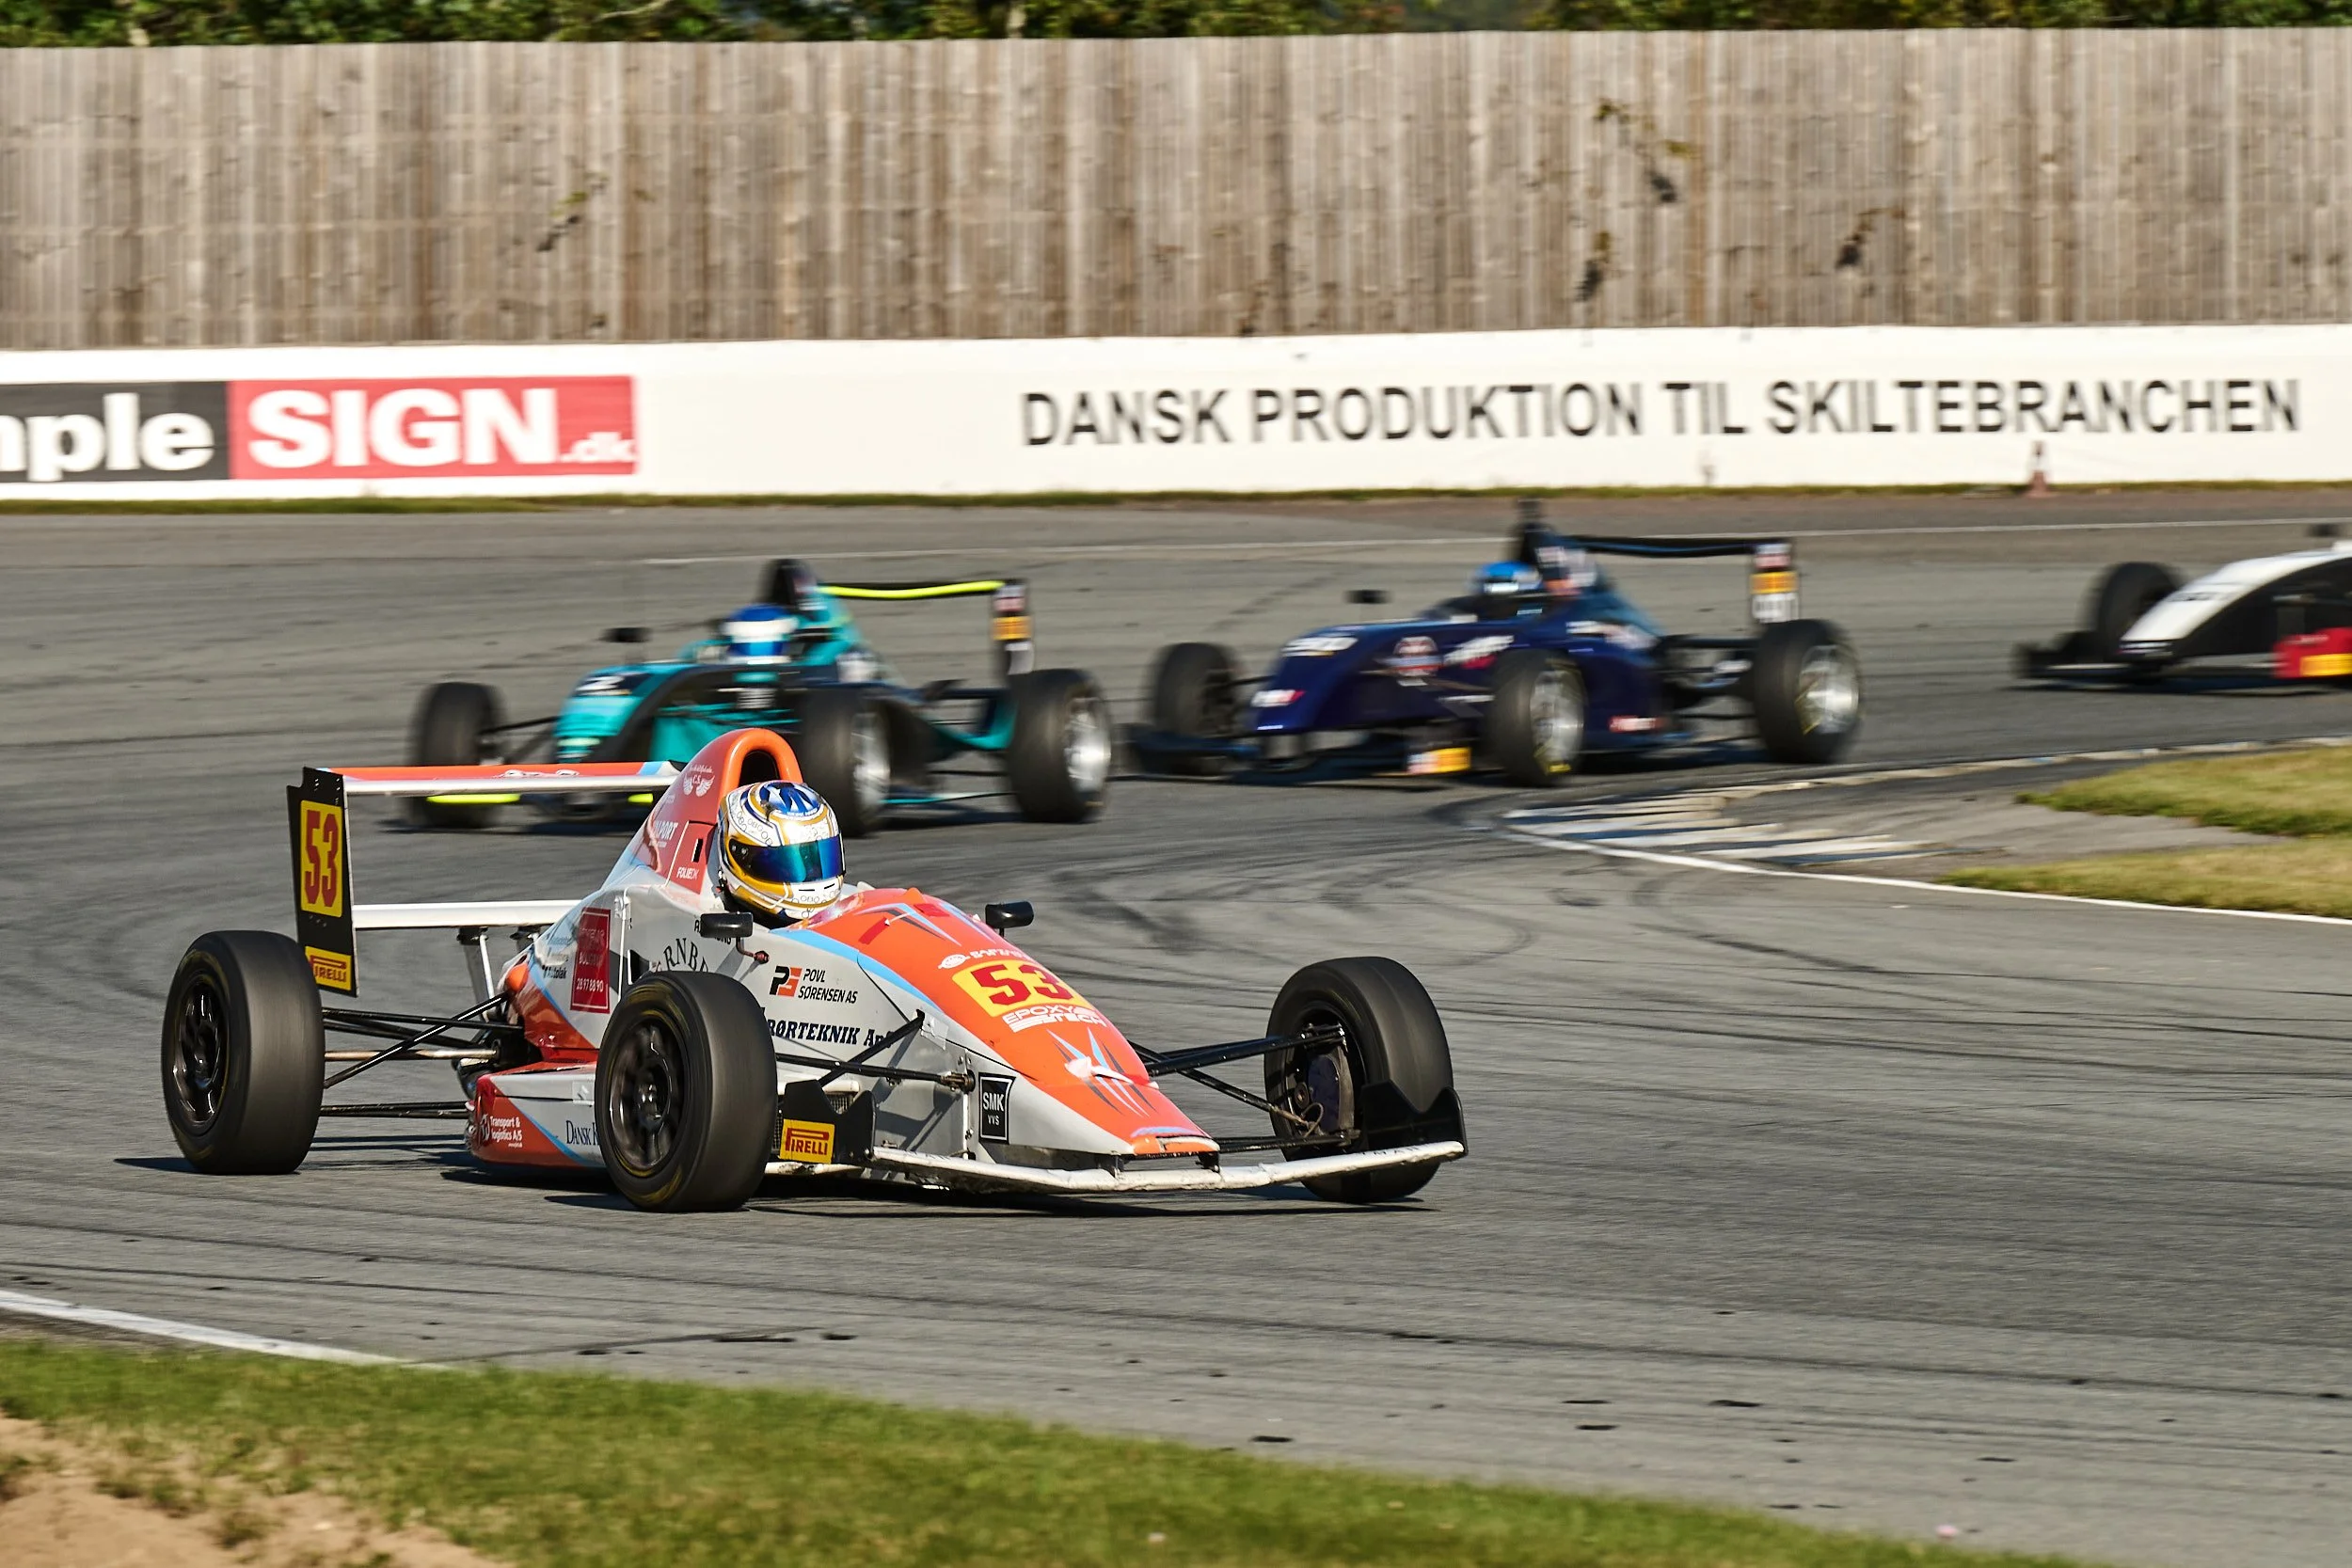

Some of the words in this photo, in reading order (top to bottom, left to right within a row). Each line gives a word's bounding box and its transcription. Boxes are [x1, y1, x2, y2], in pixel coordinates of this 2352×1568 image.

[1022, 388, 1230, 446] DANSK
[1248, 382, 1644, 443] PRODUKTION
[1661, 381, 1750, 435] TIL
[1766, 379, 2300, 435] SKILTEBRANCHEN
[0, 393, 215, 482] ple
[304, 809, 339, 908] 53
[803, 968, 826, 982] POVL
[970, 963, 1073, 1006] 53
[798, 985, 845, 1004] SØRENSEN
[845, 990, 858, 1004] AS
[1002, 1005, 1074, 1025] EPOXY
[982, 1091, 1005, 1112] SMK
[489, 1116, 515, 1131] Transport
[785, 1127, 830, 1155] PIRELLI
